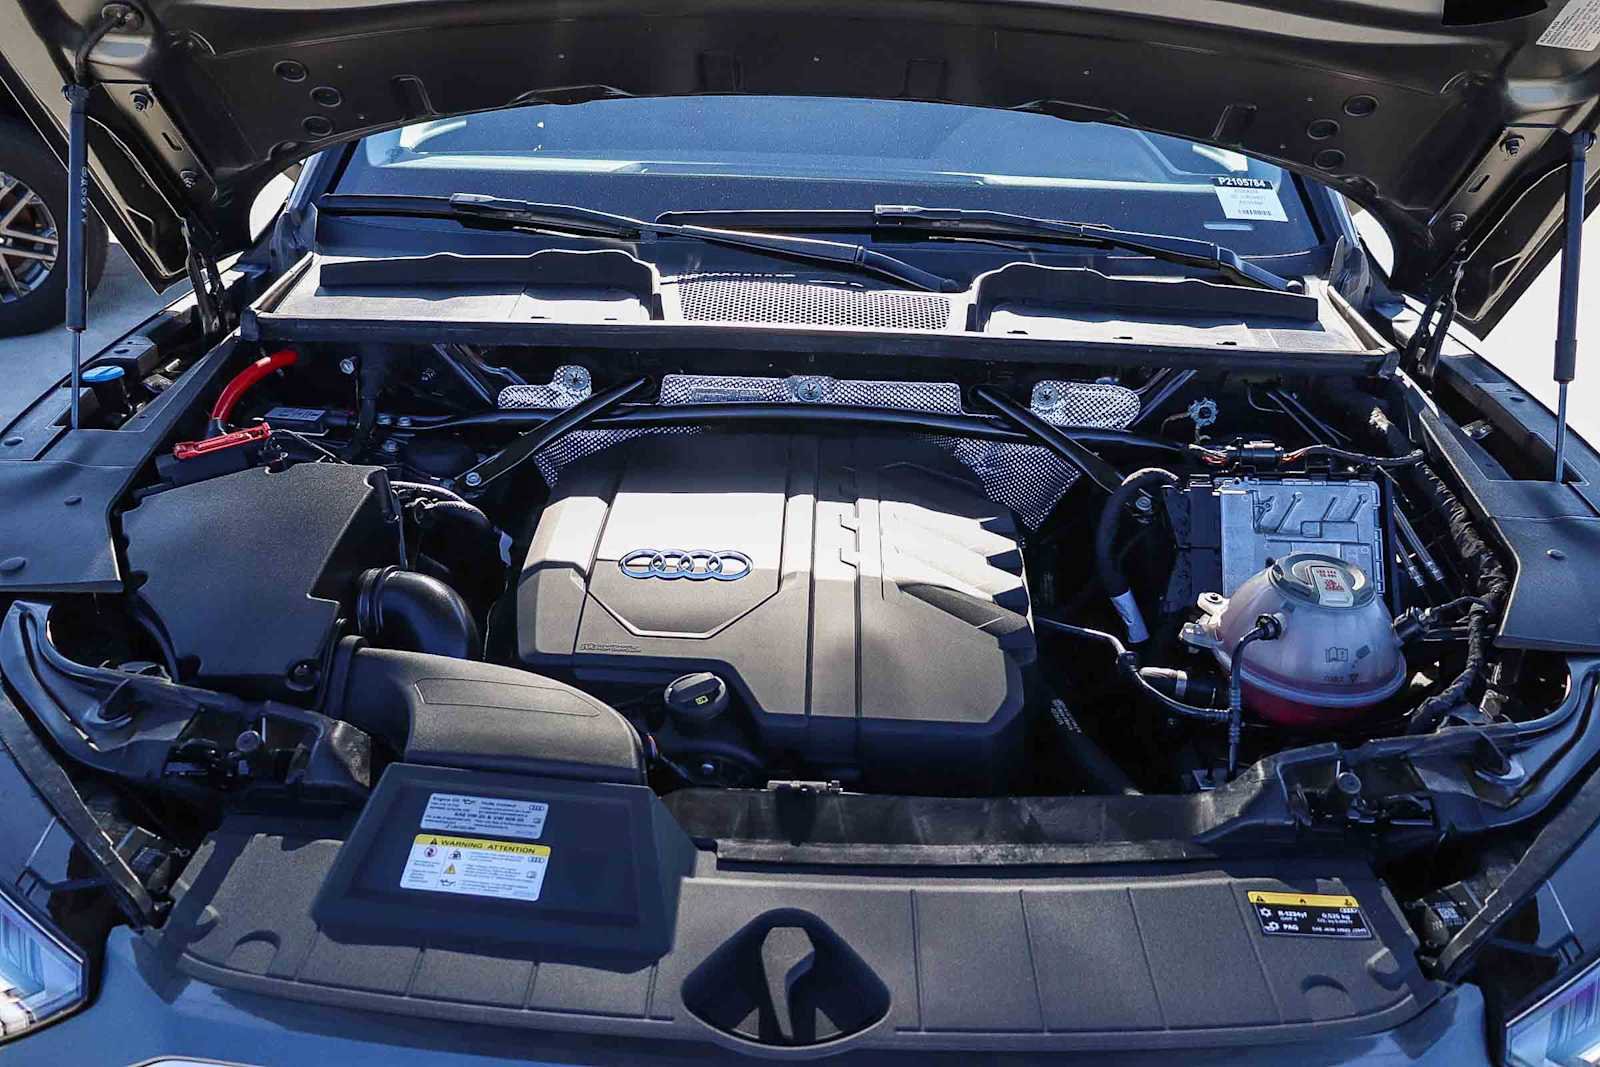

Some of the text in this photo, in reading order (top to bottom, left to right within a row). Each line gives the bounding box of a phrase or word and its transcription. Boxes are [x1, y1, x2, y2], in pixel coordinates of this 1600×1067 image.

[1217, 176, 1266, 188] P2105784
[440, 838, 484, 850] WARNING
[486, 842, 536, 855] ATTENTION
[1282, 923, 1299, 931] PAG
